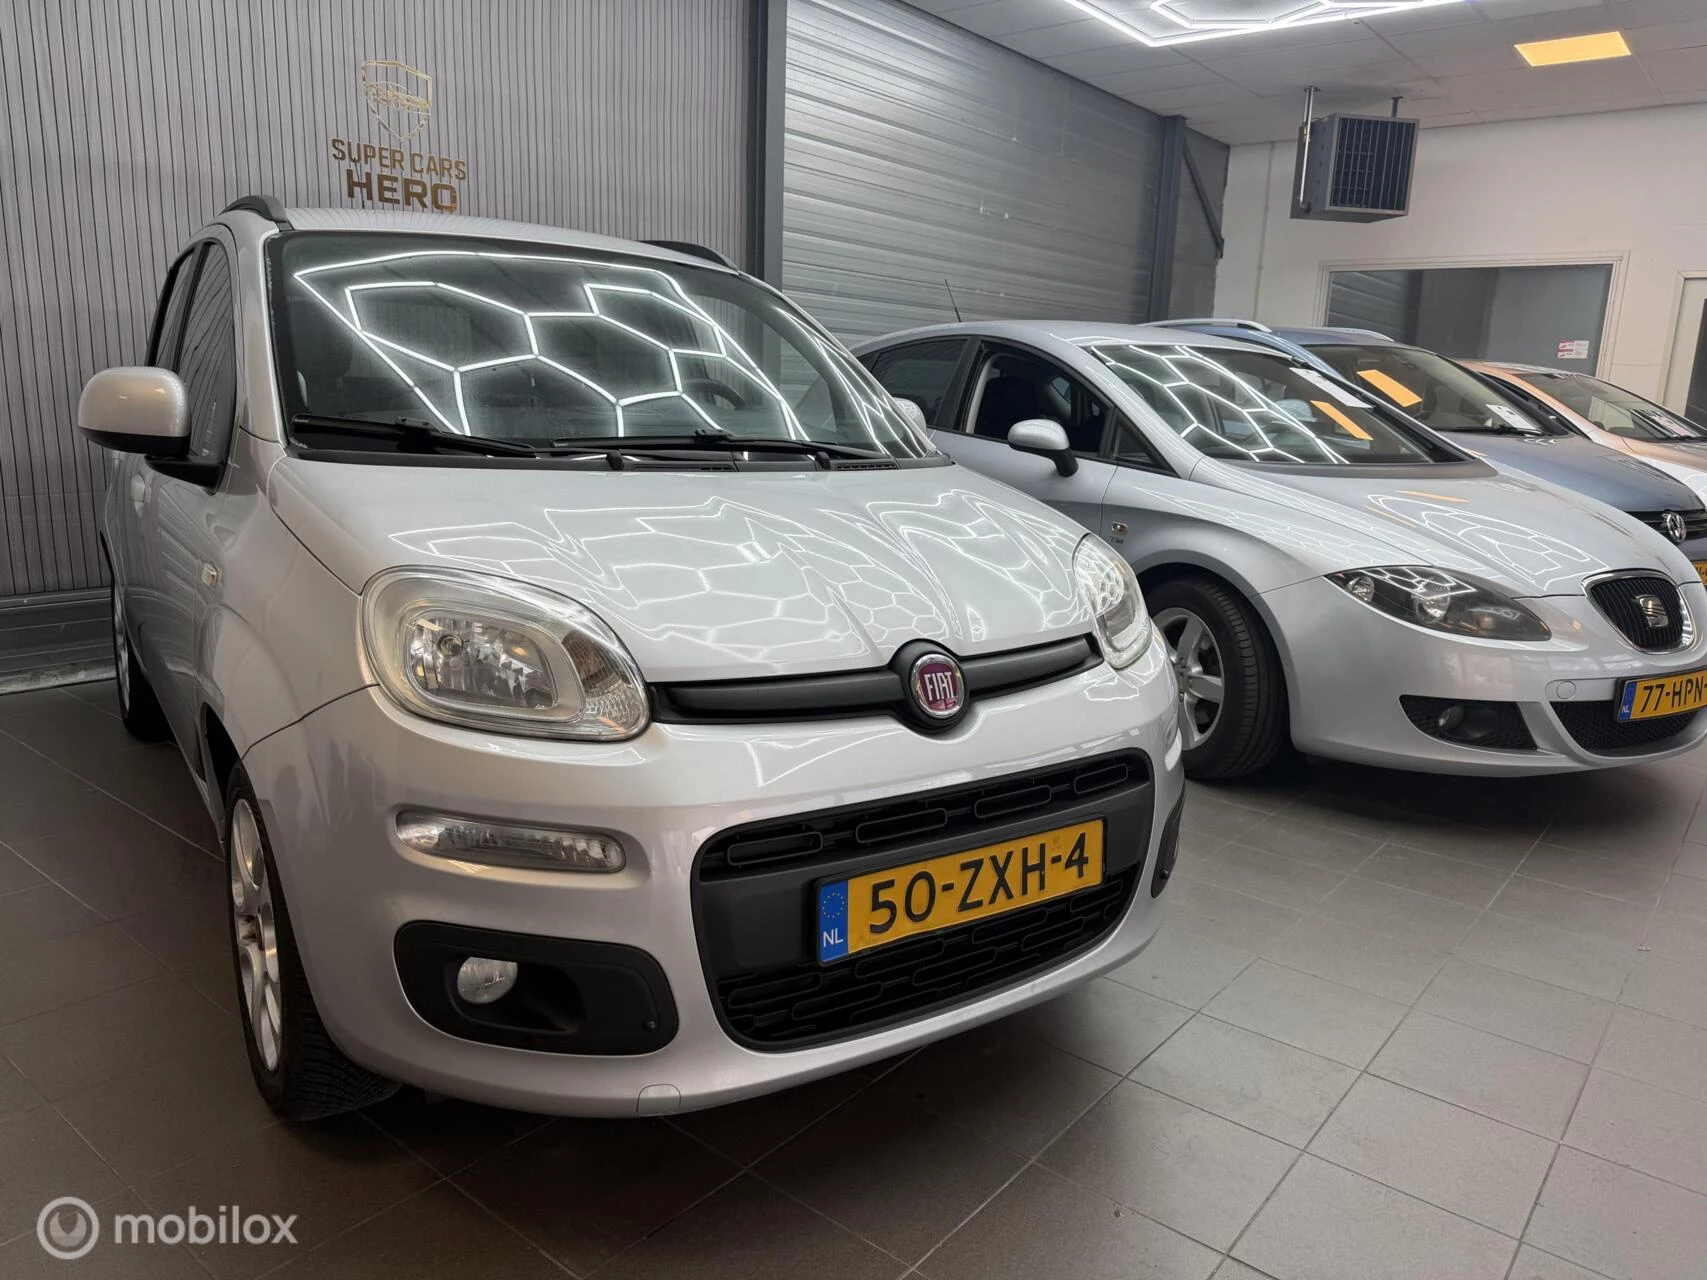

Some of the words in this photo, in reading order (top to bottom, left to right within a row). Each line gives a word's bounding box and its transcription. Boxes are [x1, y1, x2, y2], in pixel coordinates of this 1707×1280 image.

[331, 138, 405, 171] SUPER
[411, 152, 467, 181] CARS
[346, 168, 458, 213] HERO
[923, 671, 957, 701] FIAT
[869, 832, 1089, 934] 50-ZXH-4
[822, 927, 844, 948] NL
